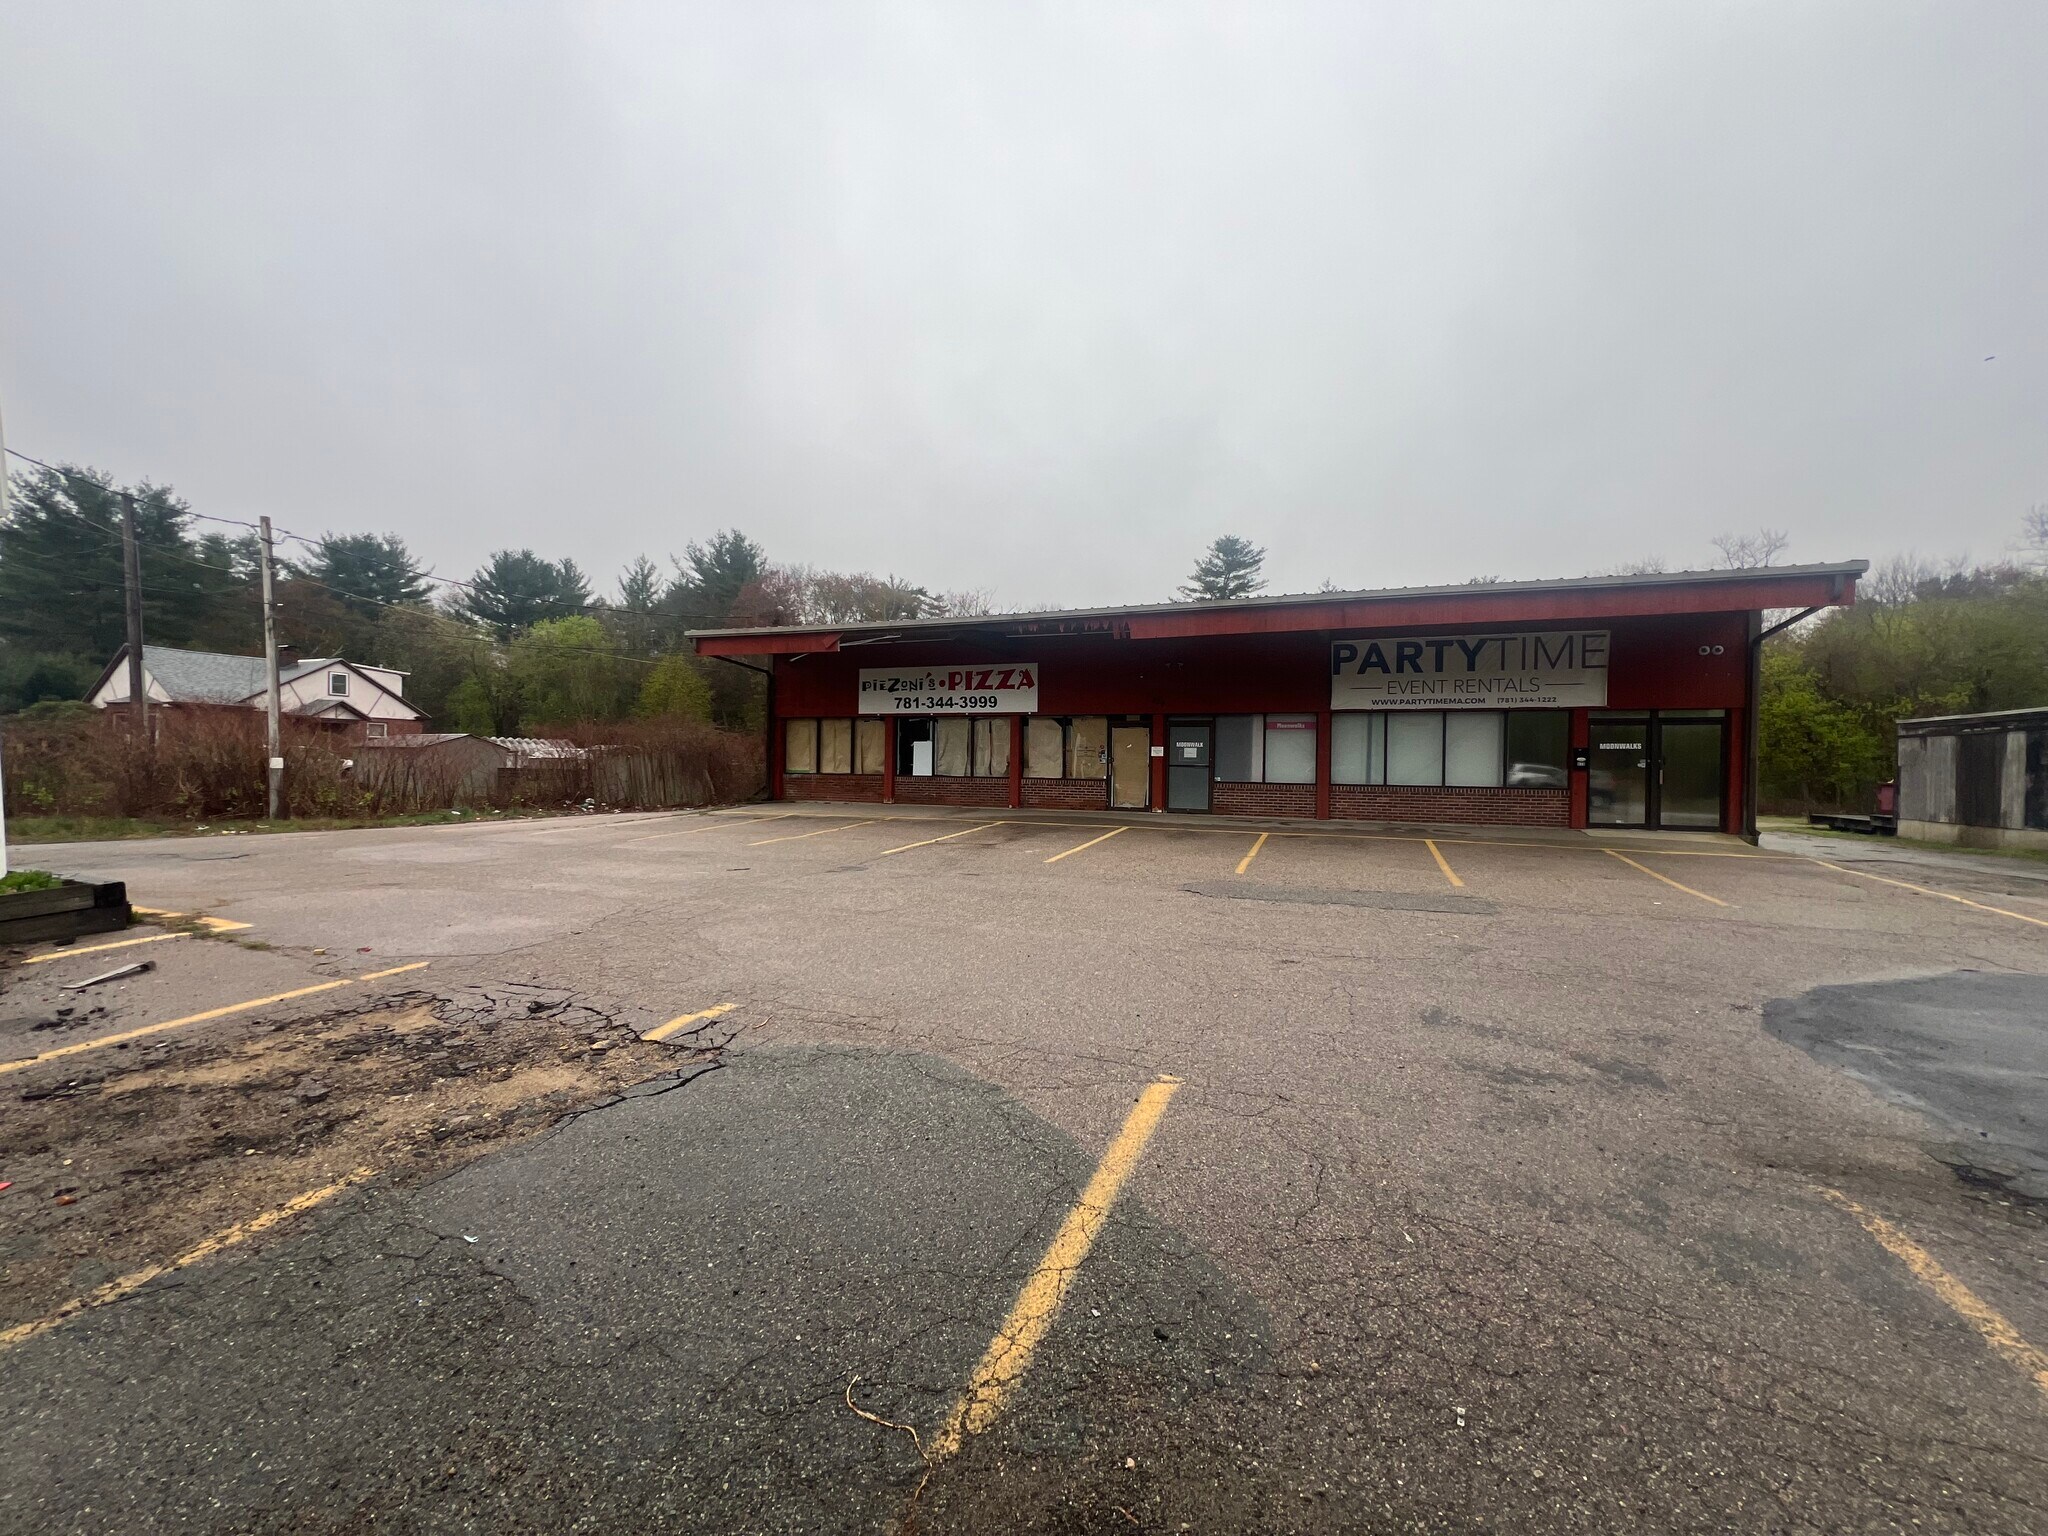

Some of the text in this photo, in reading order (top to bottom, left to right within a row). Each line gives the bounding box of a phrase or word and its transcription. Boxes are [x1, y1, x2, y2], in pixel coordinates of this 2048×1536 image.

[1331, 634, 1608, 676] PARTYTIME
[947, 668, 1036, 691] PIZZA
[1386, 677, 1541, 695] EVENT RENTALS
[894, 695, 998, 709] 781-344-3999
[1371, 697, 1486, 706] WWW.PARTYTIMEMA.COM
